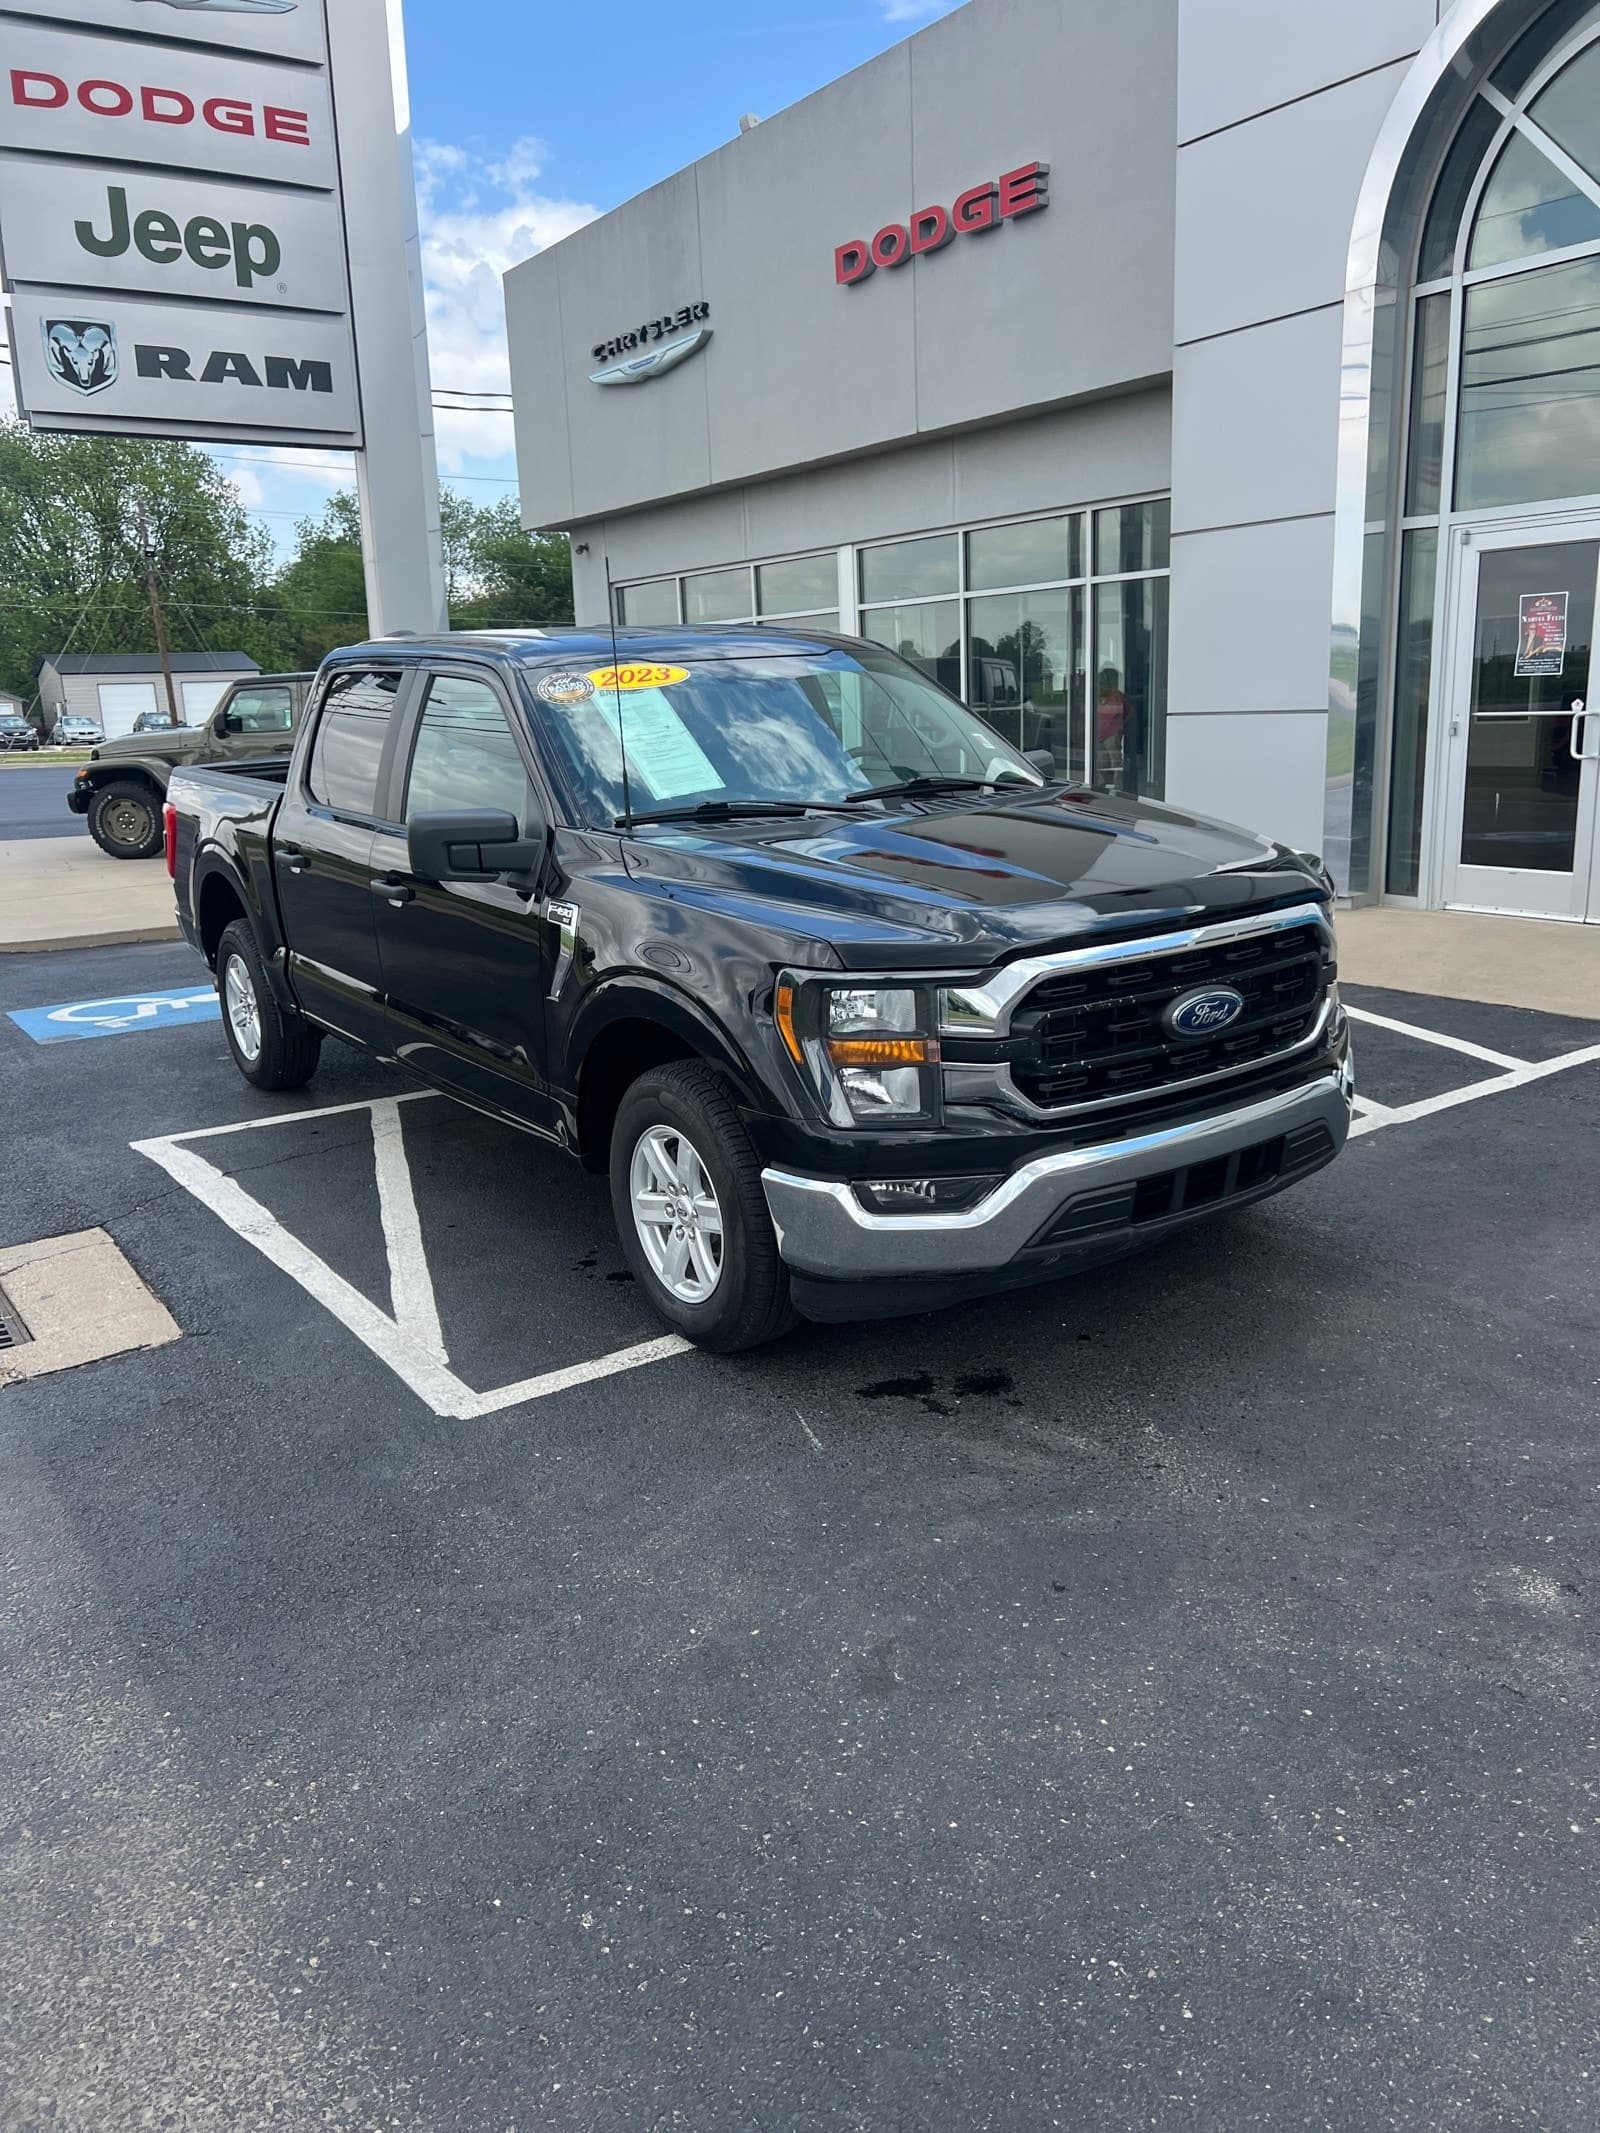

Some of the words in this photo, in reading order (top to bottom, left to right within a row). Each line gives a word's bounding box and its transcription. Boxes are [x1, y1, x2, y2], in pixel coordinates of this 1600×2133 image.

[10, 69, 310, 146] DODGE
[74, 186, 281, 288] Jeep
[834, 161, 1049, 286] DODGE
[592, 302, 709, 361] CHRYSLER
[134, 344, 333, 393] RAM
[601, 667, 671, 687] 2023
[1192, 1000, 1229, 1027] Ford
